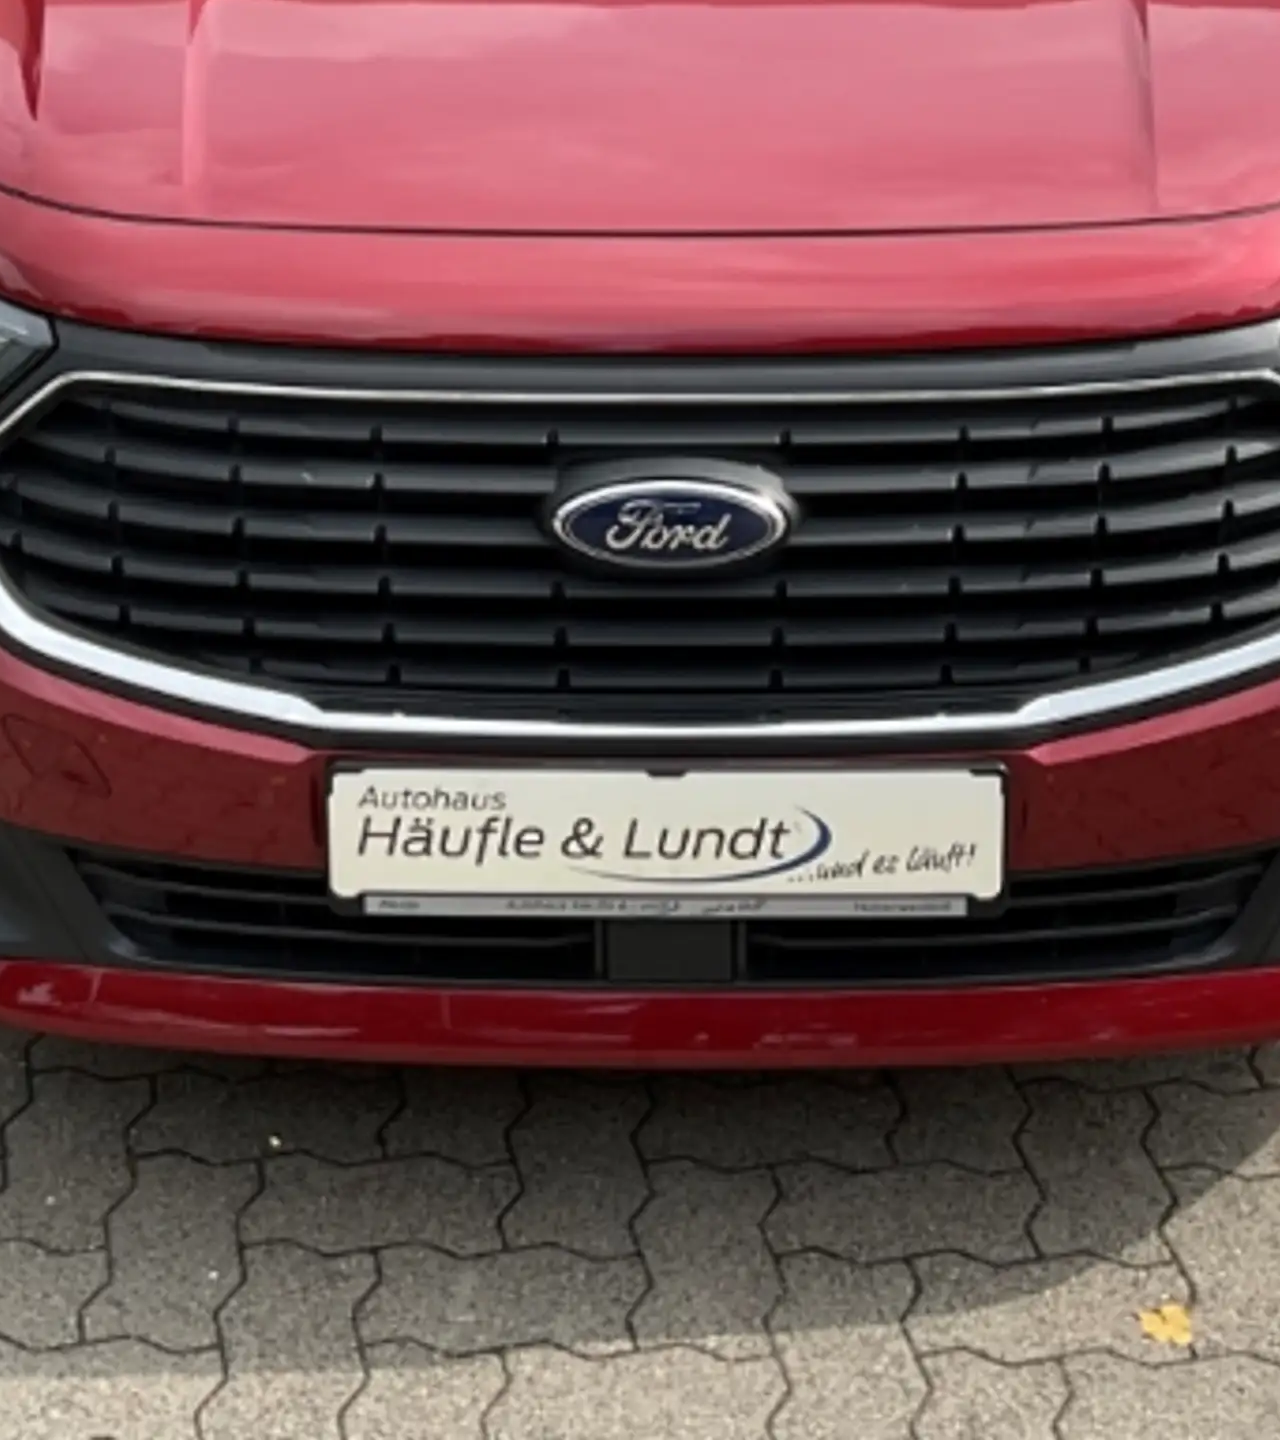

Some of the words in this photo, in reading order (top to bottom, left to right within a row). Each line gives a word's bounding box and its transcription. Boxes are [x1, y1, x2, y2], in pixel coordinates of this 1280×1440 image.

[606, 499, 732, 549] Ford
[358, 785, 507, 811] Autohaus
[357, 815, 545, 867] Häufle
[561, 817, 603, 859] &
[624, 817, 790, 860] Lundt
